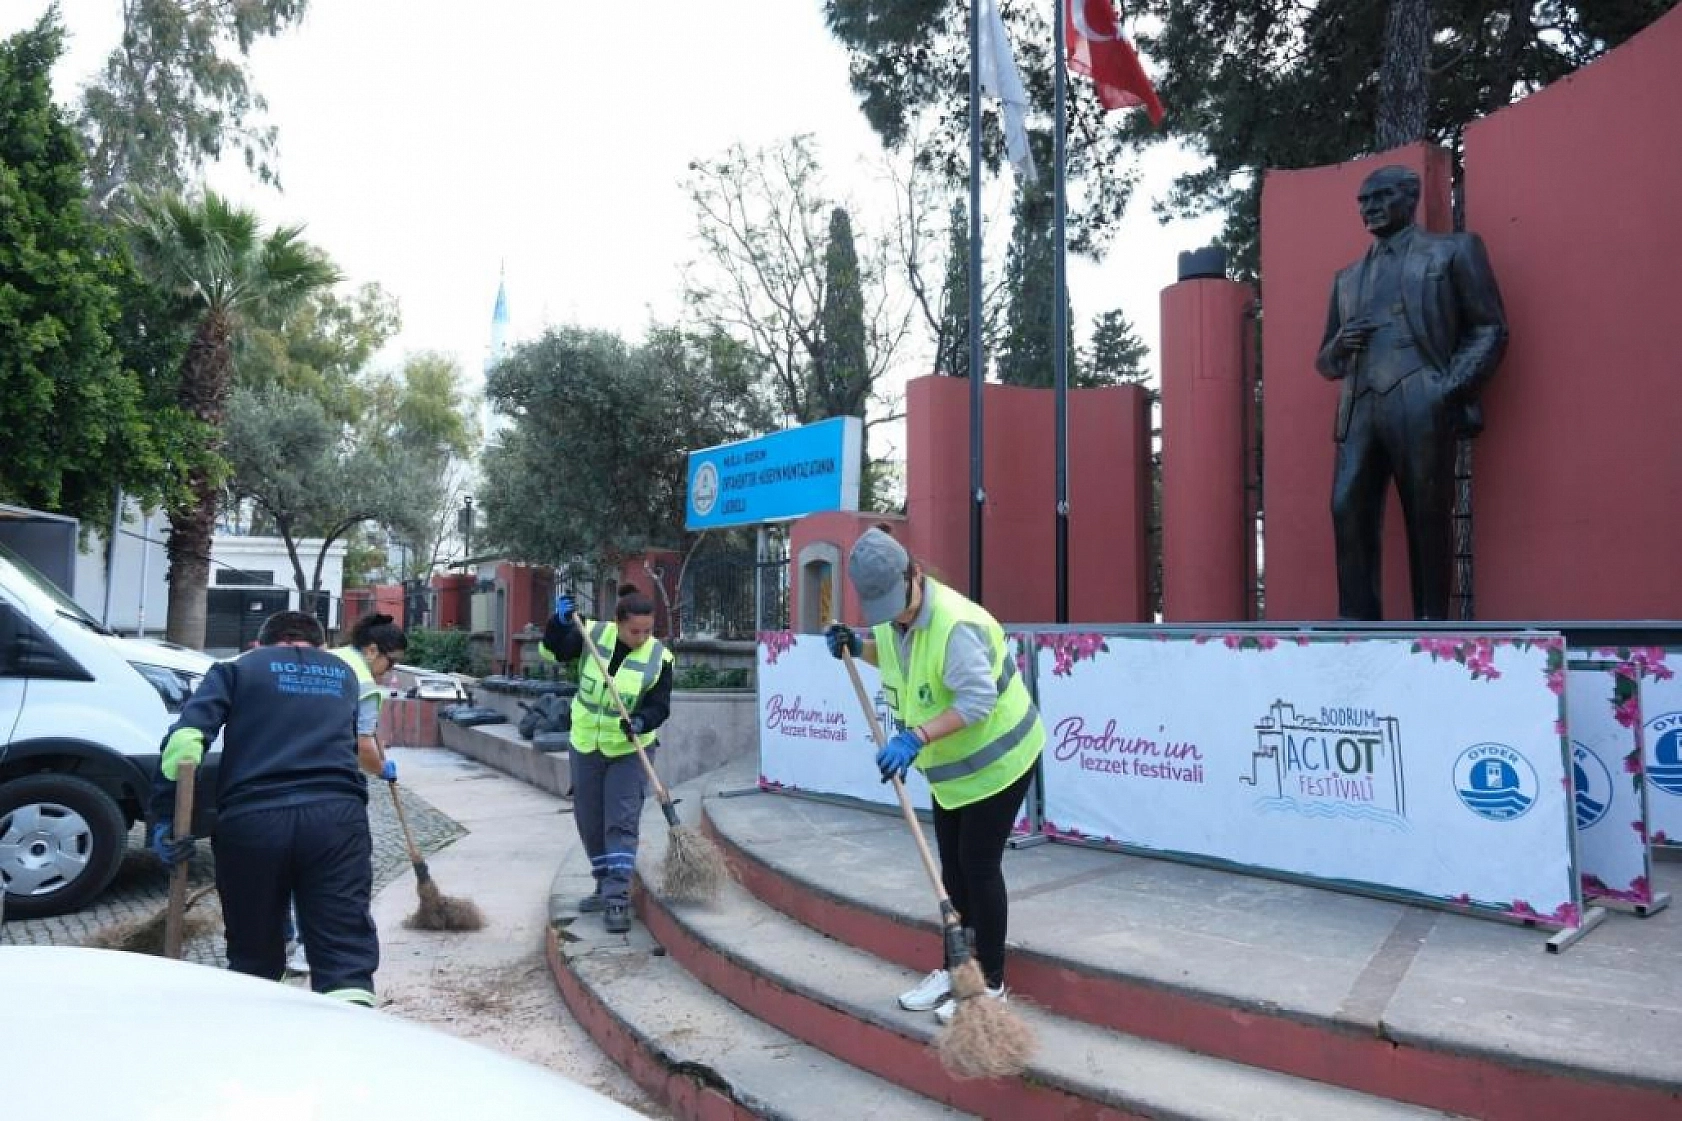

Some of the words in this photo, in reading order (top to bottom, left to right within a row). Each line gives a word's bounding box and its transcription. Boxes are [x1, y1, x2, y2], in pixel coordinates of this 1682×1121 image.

[270, 662, 346, 678] BODRUM
[766, 694, 847, 729] Bodrum'un
[1321, 706, 1378, 727] BODRUM
[809, 726, 848, 741] festivali
[1054, 716, 1203, 761] Bodrum'un
[1080, 752, 1128, 775] lezzet
[1133, 757, 1203, 783] festivali
